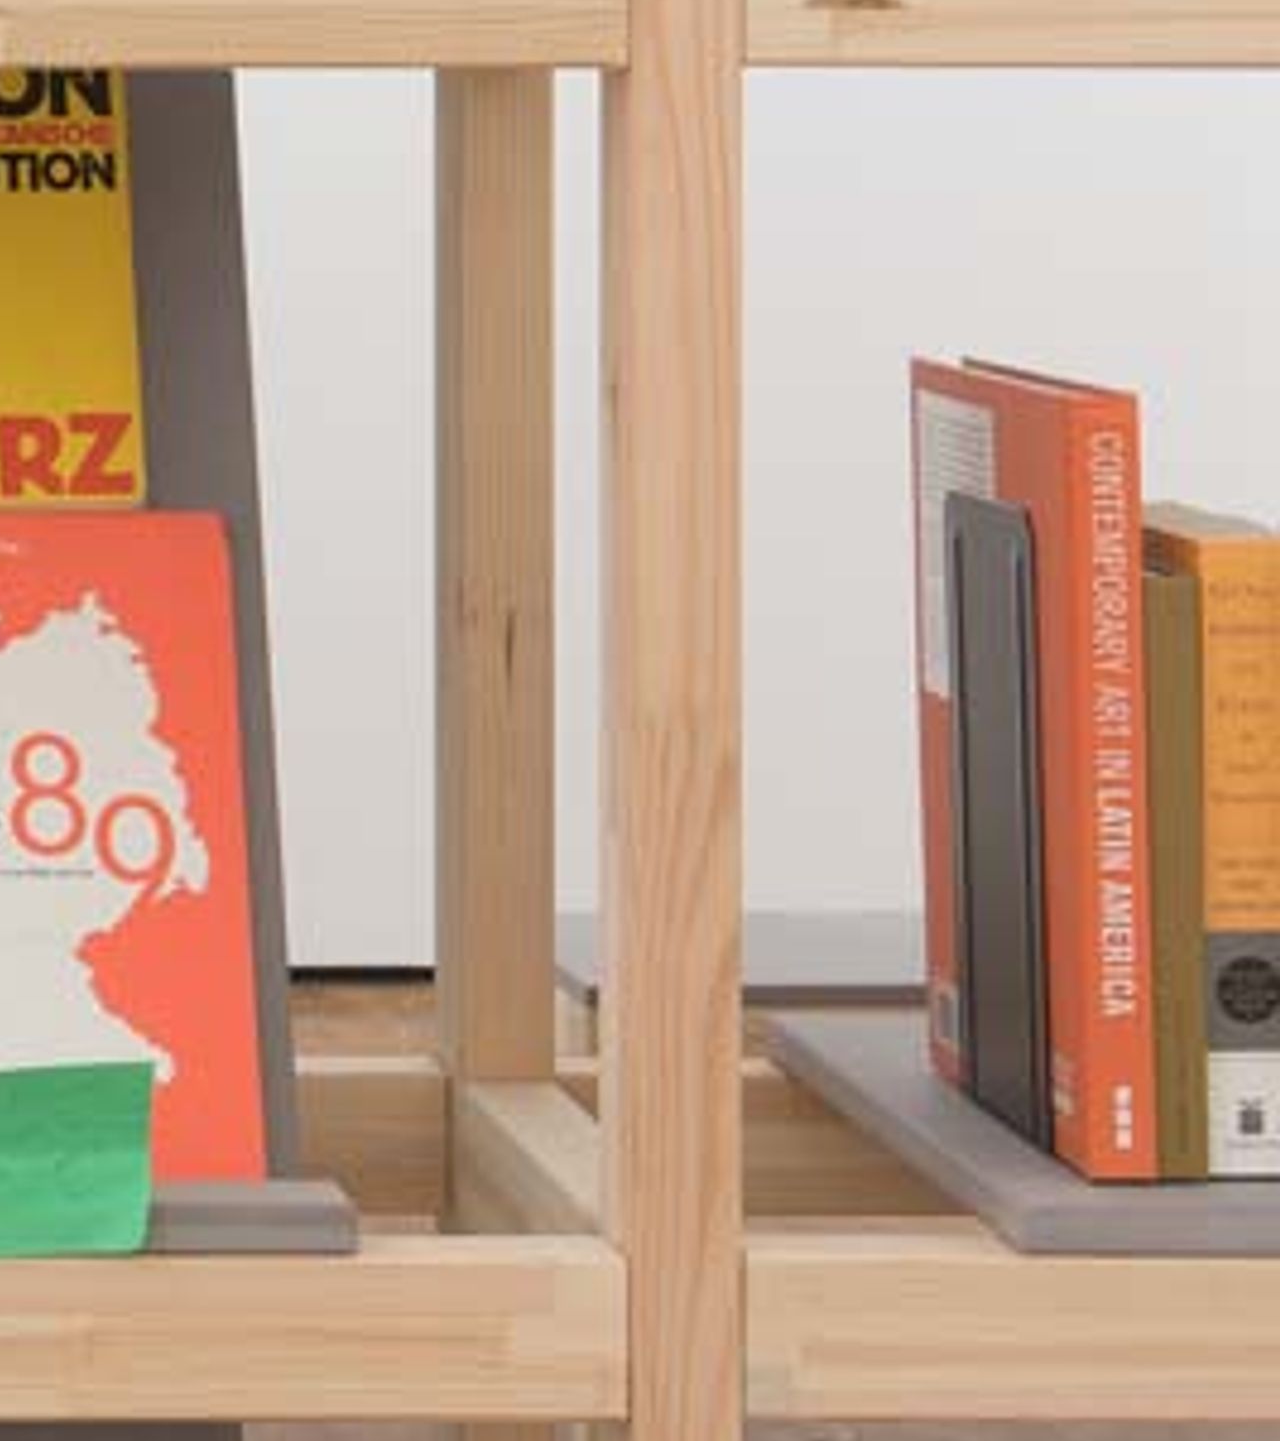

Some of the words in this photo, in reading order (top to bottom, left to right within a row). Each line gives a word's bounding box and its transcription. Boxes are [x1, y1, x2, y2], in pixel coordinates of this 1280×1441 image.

[1089, 431, 1131, 673] CONTEMPORARY
[1093, 685, 1132, 738] ART
[1095, 748, 1132, 781] IN
[10, 733, 177, 900] 89
[1096, 788, 1134, 867] LATIN
[1099, 880, 1137, 1018] AMERICA
